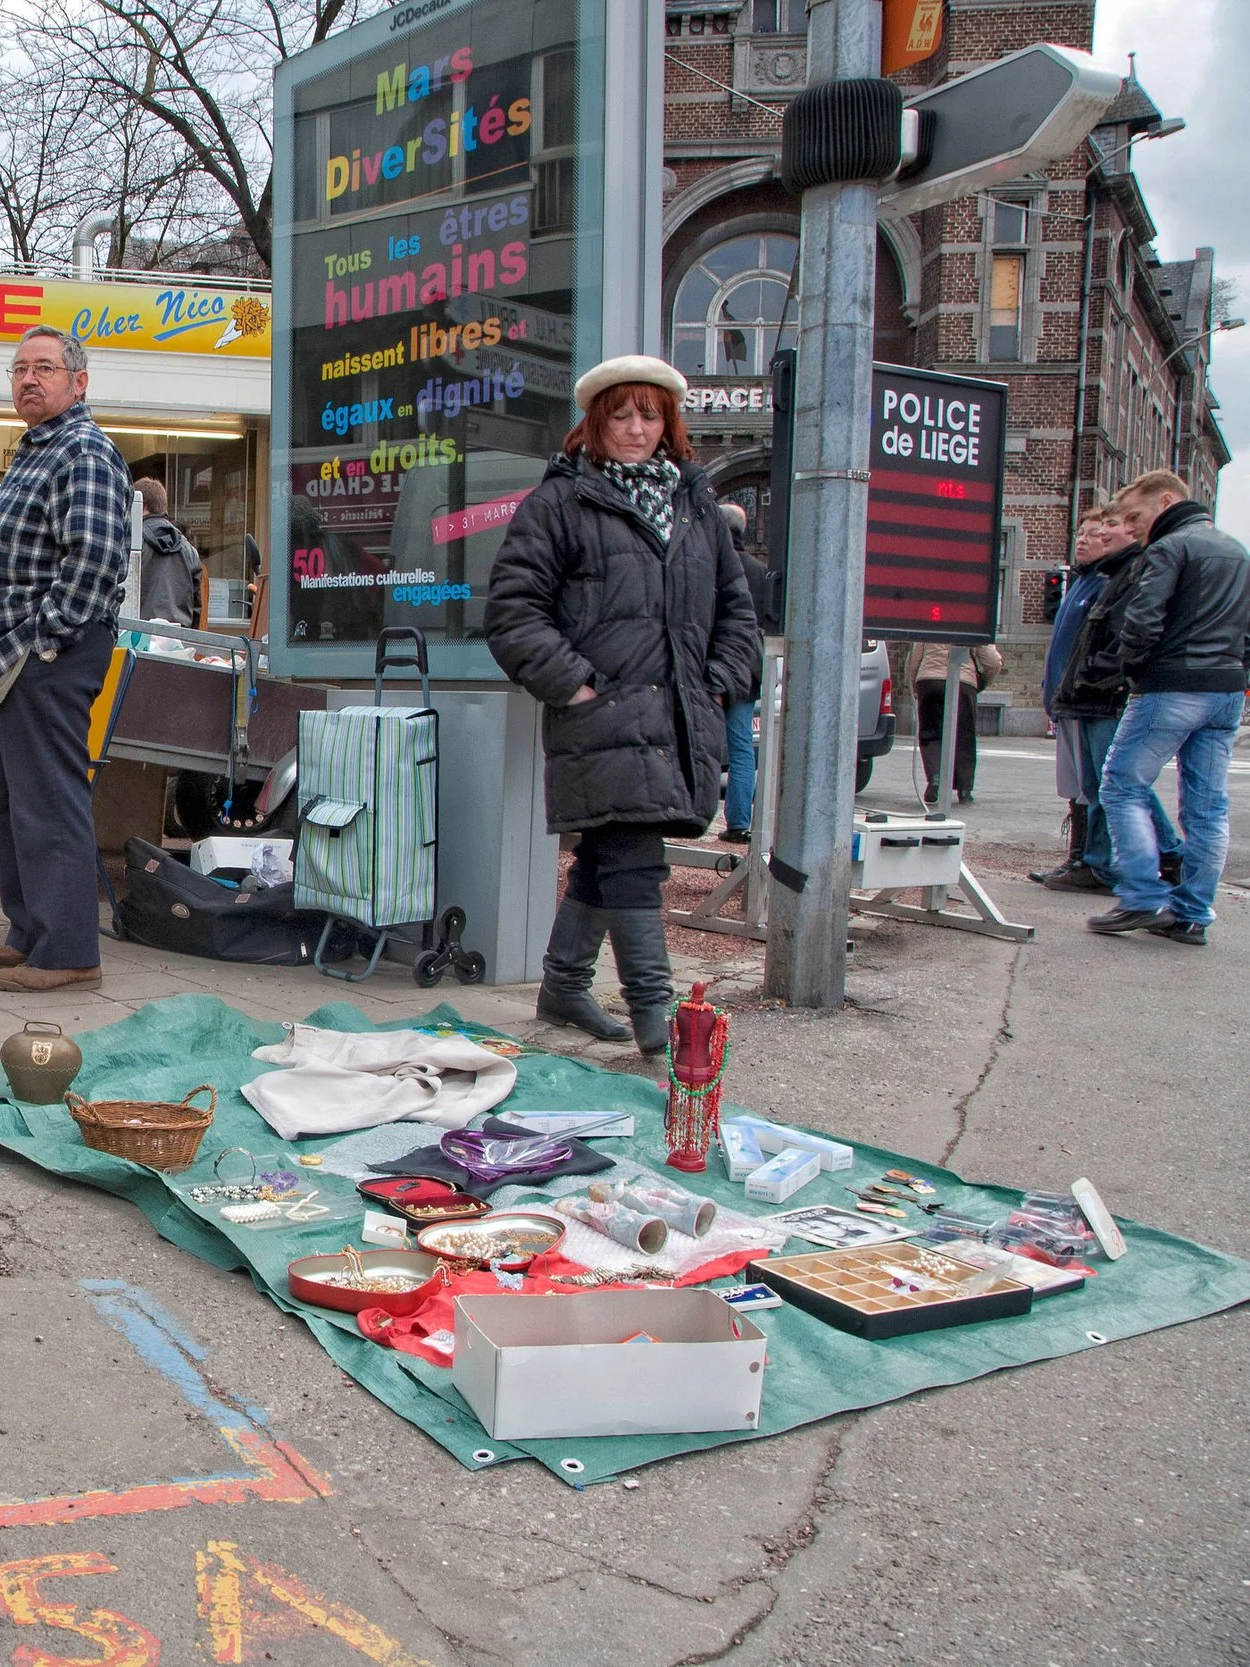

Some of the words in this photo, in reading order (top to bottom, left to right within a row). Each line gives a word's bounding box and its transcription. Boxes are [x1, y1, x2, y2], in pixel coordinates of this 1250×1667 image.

[375, 47, 473, 116] Mars
[325, 249, 372, 279] Tous
[388, 234, 421, 261] les
[440, 196, 528, 246] êtres
[325, 240, 527, 330] humains
[155, 288, 226, 326] Nico
[321, 342, 404, 381] naissent
[410, 315, 501, 362] libres
[507, 319, 527, 341] et
[321, 396, 395, 436] égaux
[397, 401, 413, 417] en
[416, 361, 525, 418] dignité
[680, 388, 763, 408] SPACE
[883, 389, 981, 434] POLICE
[320, 455, 341, 481] et
[346, 459, 366, 477] en
[370, 432, 464, 475] droits.
[882, 425, 914, 457] de
[920, 429, 980, 466] LIEGE
[484, 501, 517, 523] MARS
[293, 547, 325, 583] 50
[301, 572, 374, 589] Manifestations
[376, 568, 435, 585] culturelles
[392, 578, 472, 607] engagées
